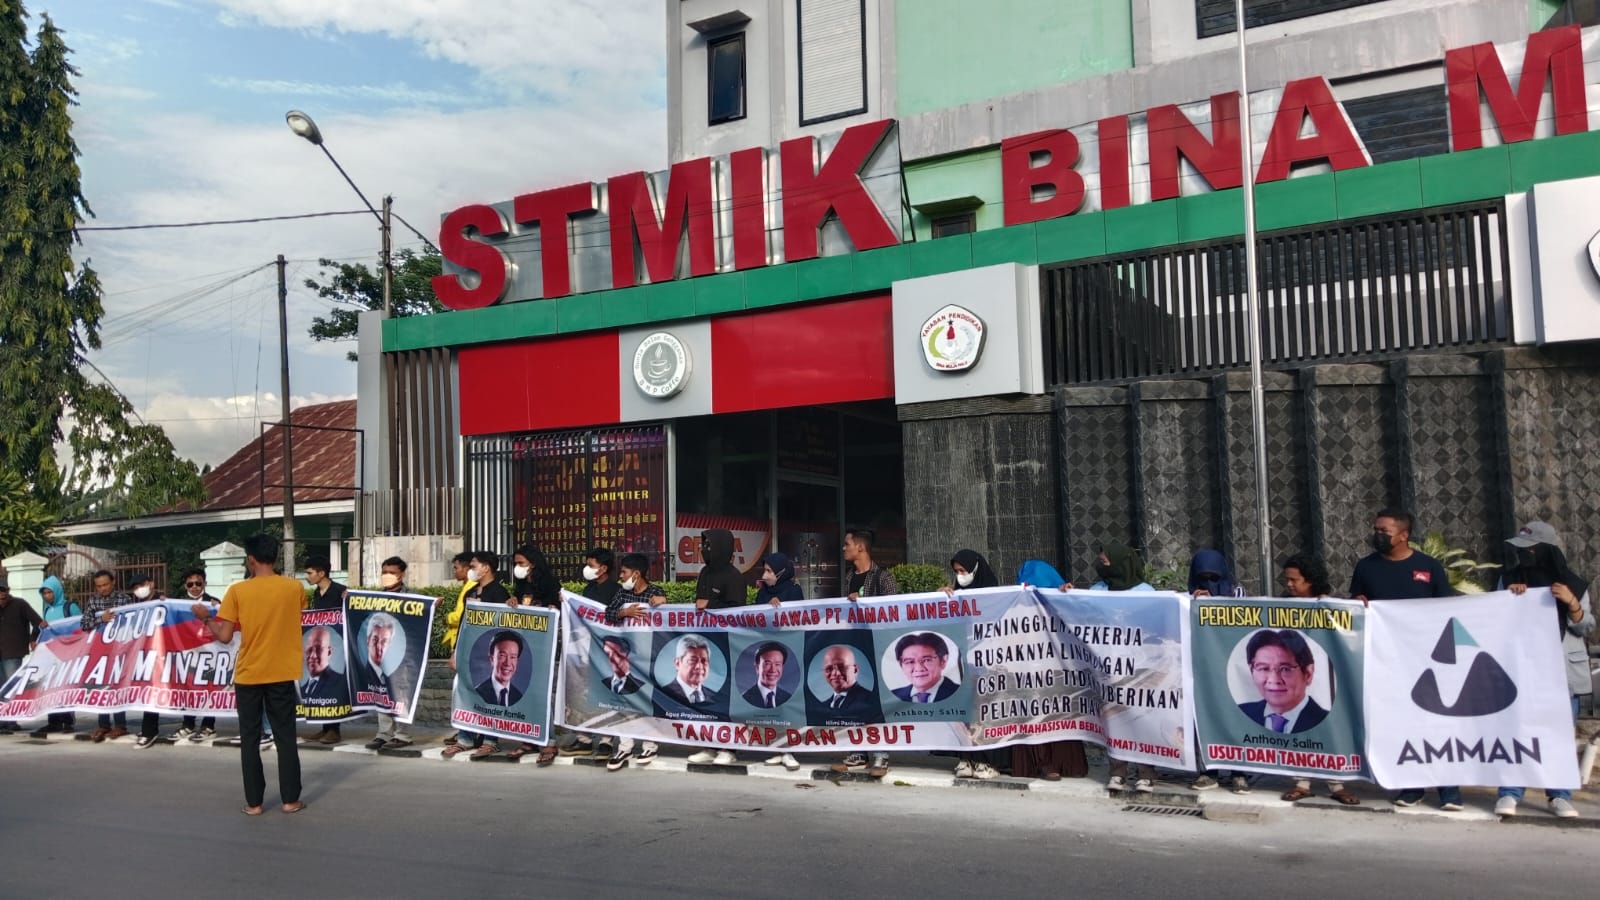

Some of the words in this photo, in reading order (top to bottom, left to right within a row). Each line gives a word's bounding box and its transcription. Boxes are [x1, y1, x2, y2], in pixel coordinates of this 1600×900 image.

[431, 118, 900, 310] STMIK
[1001, 76, 1371, 226] BINA
[302, 610, 338, 626] RAMPAS
[349, 596, 403, 613] PERAMPOK
[403, 601, 425, 617] CSR
[772, 608, 820, 627] JAWAB
[825, 608, 842, 624] PT
[906, 599, 981, 620] MINERAL
[1200, 606, 1263, 627] PERUSAK
[1268, 607, 1353, 631] LINGKUNGAN
[498, 612, 548, 632] LINGKUNGAN
[974, 642, 1054, 667] RUSAKNYA
[132, 650, 236, 686] MINER
[978, 673, 1006, 695] CSR
[1015, 669, 1054, 690] YANG
[208, 690, 238, 710] SULT
[981, 696, 1071, 721] PELANGGAR
[478, 715, 493, 728] DAN
[672, 723, 777, 745] TANGKAP
[787, 728, 836, 746] DAN
[849, 725, 915, 744] USUT
[984, 724, 1017, 738] FORUM
[1019, 720, 1077, 735] MAHASISWA
[1139, 743, 1180, 758] SULTENG
[1243, 734, 1289, 749] Anthony
[1293, 738, 1323, 750] Salim
[1208, 745, 1243, 761] USUT
[1246, 748, 1276, 765] DAN
[1396, 736, 1542, 766] AMMAN
